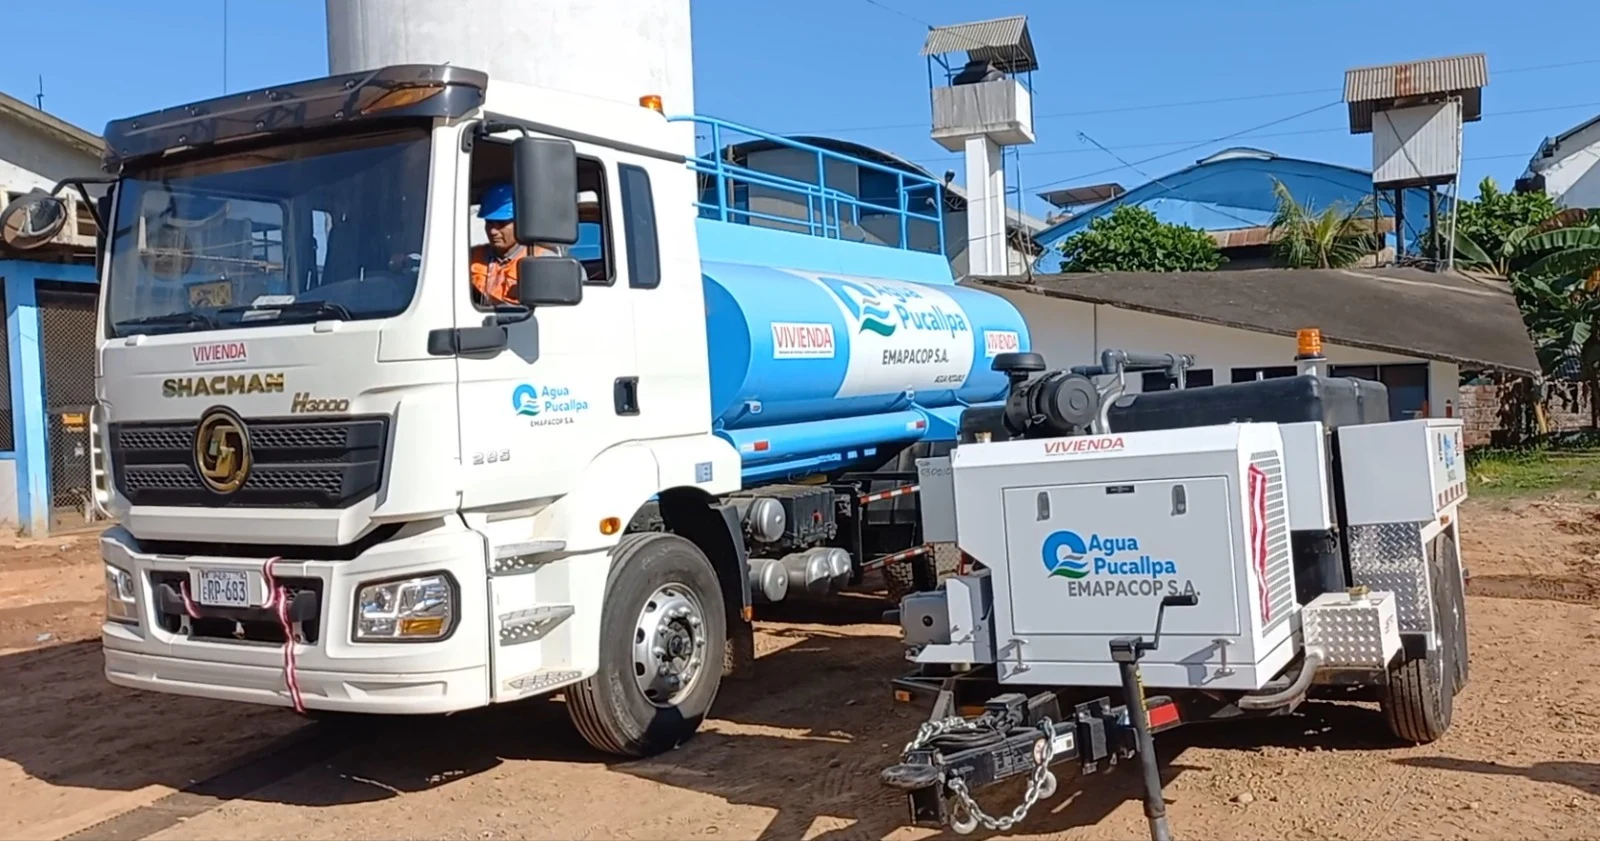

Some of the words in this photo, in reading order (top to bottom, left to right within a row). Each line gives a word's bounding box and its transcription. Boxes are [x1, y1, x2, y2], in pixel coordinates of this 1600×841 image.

[893, 304, 968, 339] Pucallpa
[773, 326, 833, 348] VIVIENDA
[985, 333, 1017, 350] VIVIENDA
[192, 342, 247, 361] VIVIENDA
[882, 349, 934, 365] EMAPACOP
[934, 348, 949, 363] S.A.
[162, 373, 285, 398] SHACMAN
[541, 385, 570, 400] Agua
[291, 392, 350, 414] H3000
[544, 399, 588, 413] Pucallpa
[1044, 437, 1125, 453] VIVIENDA
[1088, 533, 1139, 557] Agua
[1093, 555, 1177, 579] Pucallpa
[1068, 580, 1163, 598] EMAPACOP
[1167, 579, 1201, 597] S.A.
